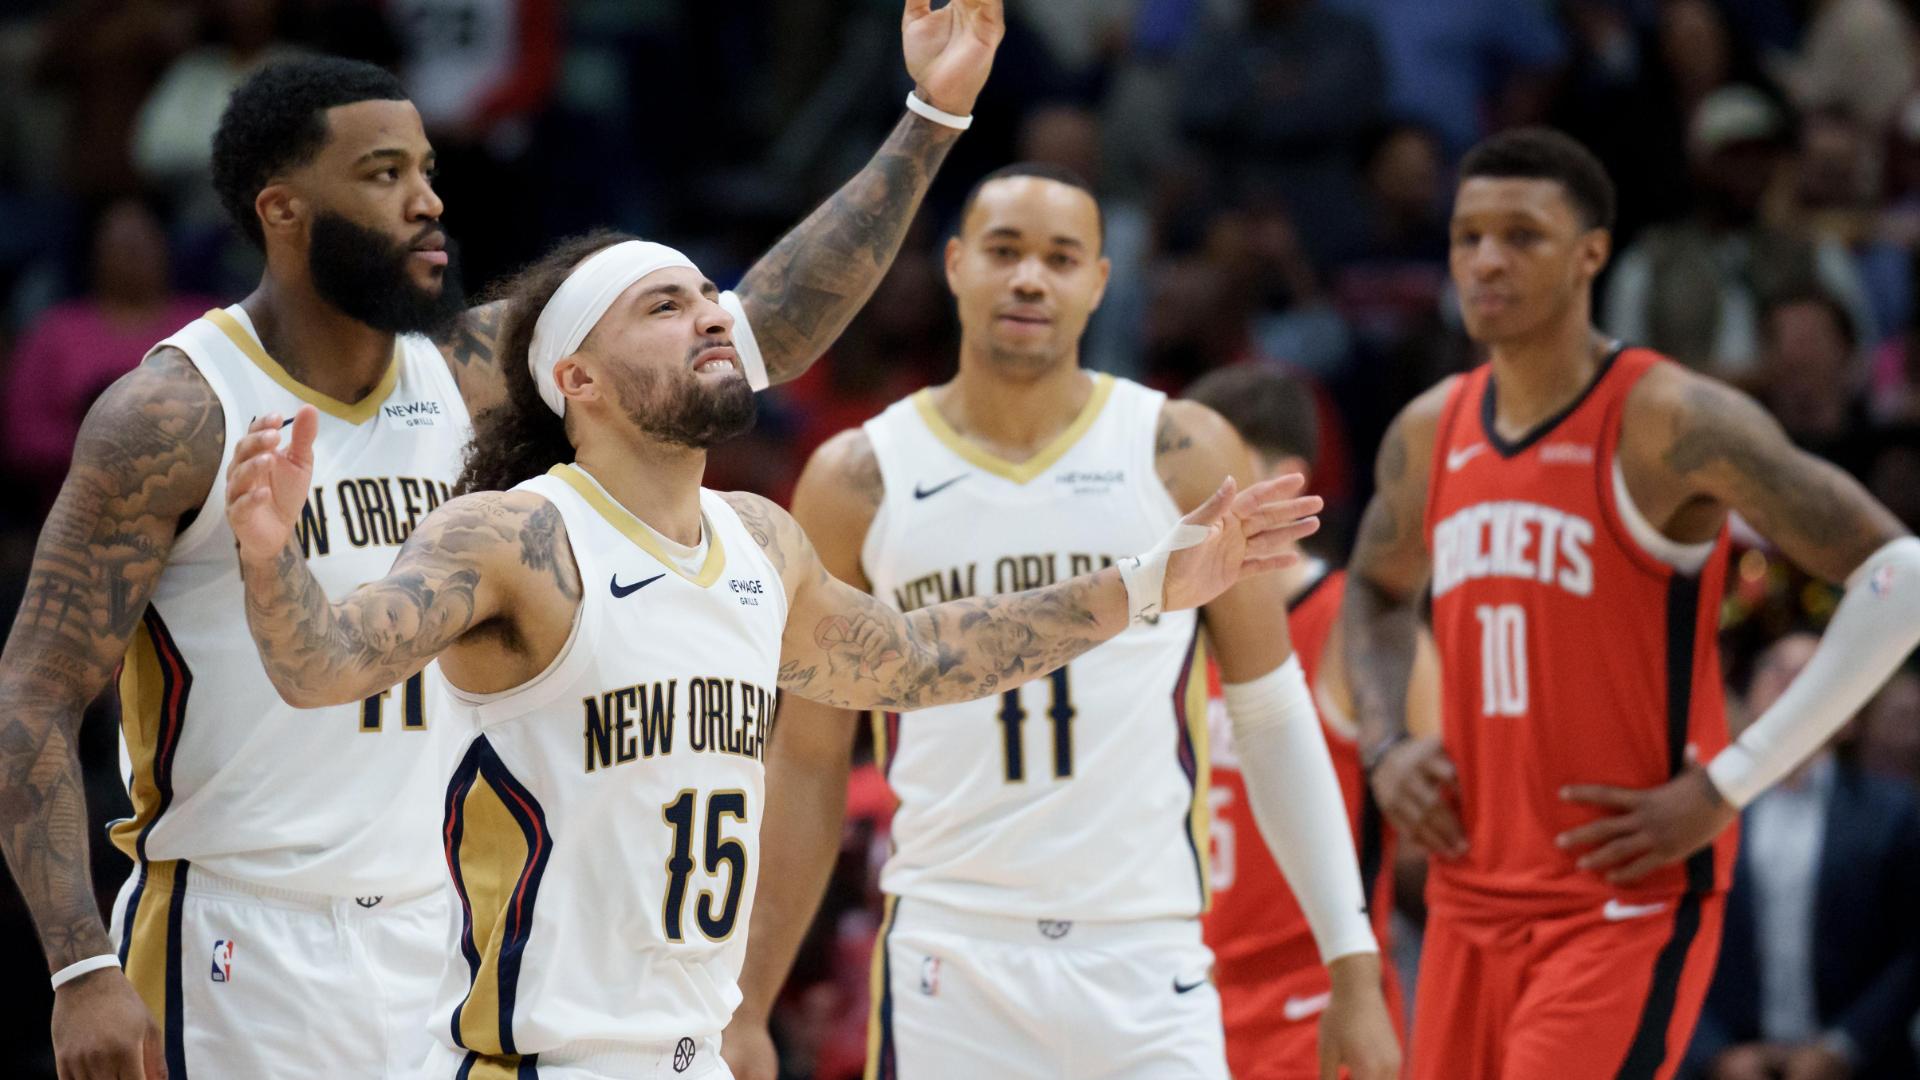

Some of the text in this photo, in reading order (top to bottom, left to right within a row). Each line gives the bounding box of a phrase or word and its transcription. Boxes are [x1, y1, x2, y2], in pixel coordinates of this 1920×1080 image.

[384, 402, 440, 417] NEWAGE
[728, 579, 763, 594] NEWAGE
[1431, 501, 1595, 598] ROCKETS
[1476, 604, 1530, 718] 10
[583, 680, 678, 774] NEW
[661, 788, 749, 945] 15
